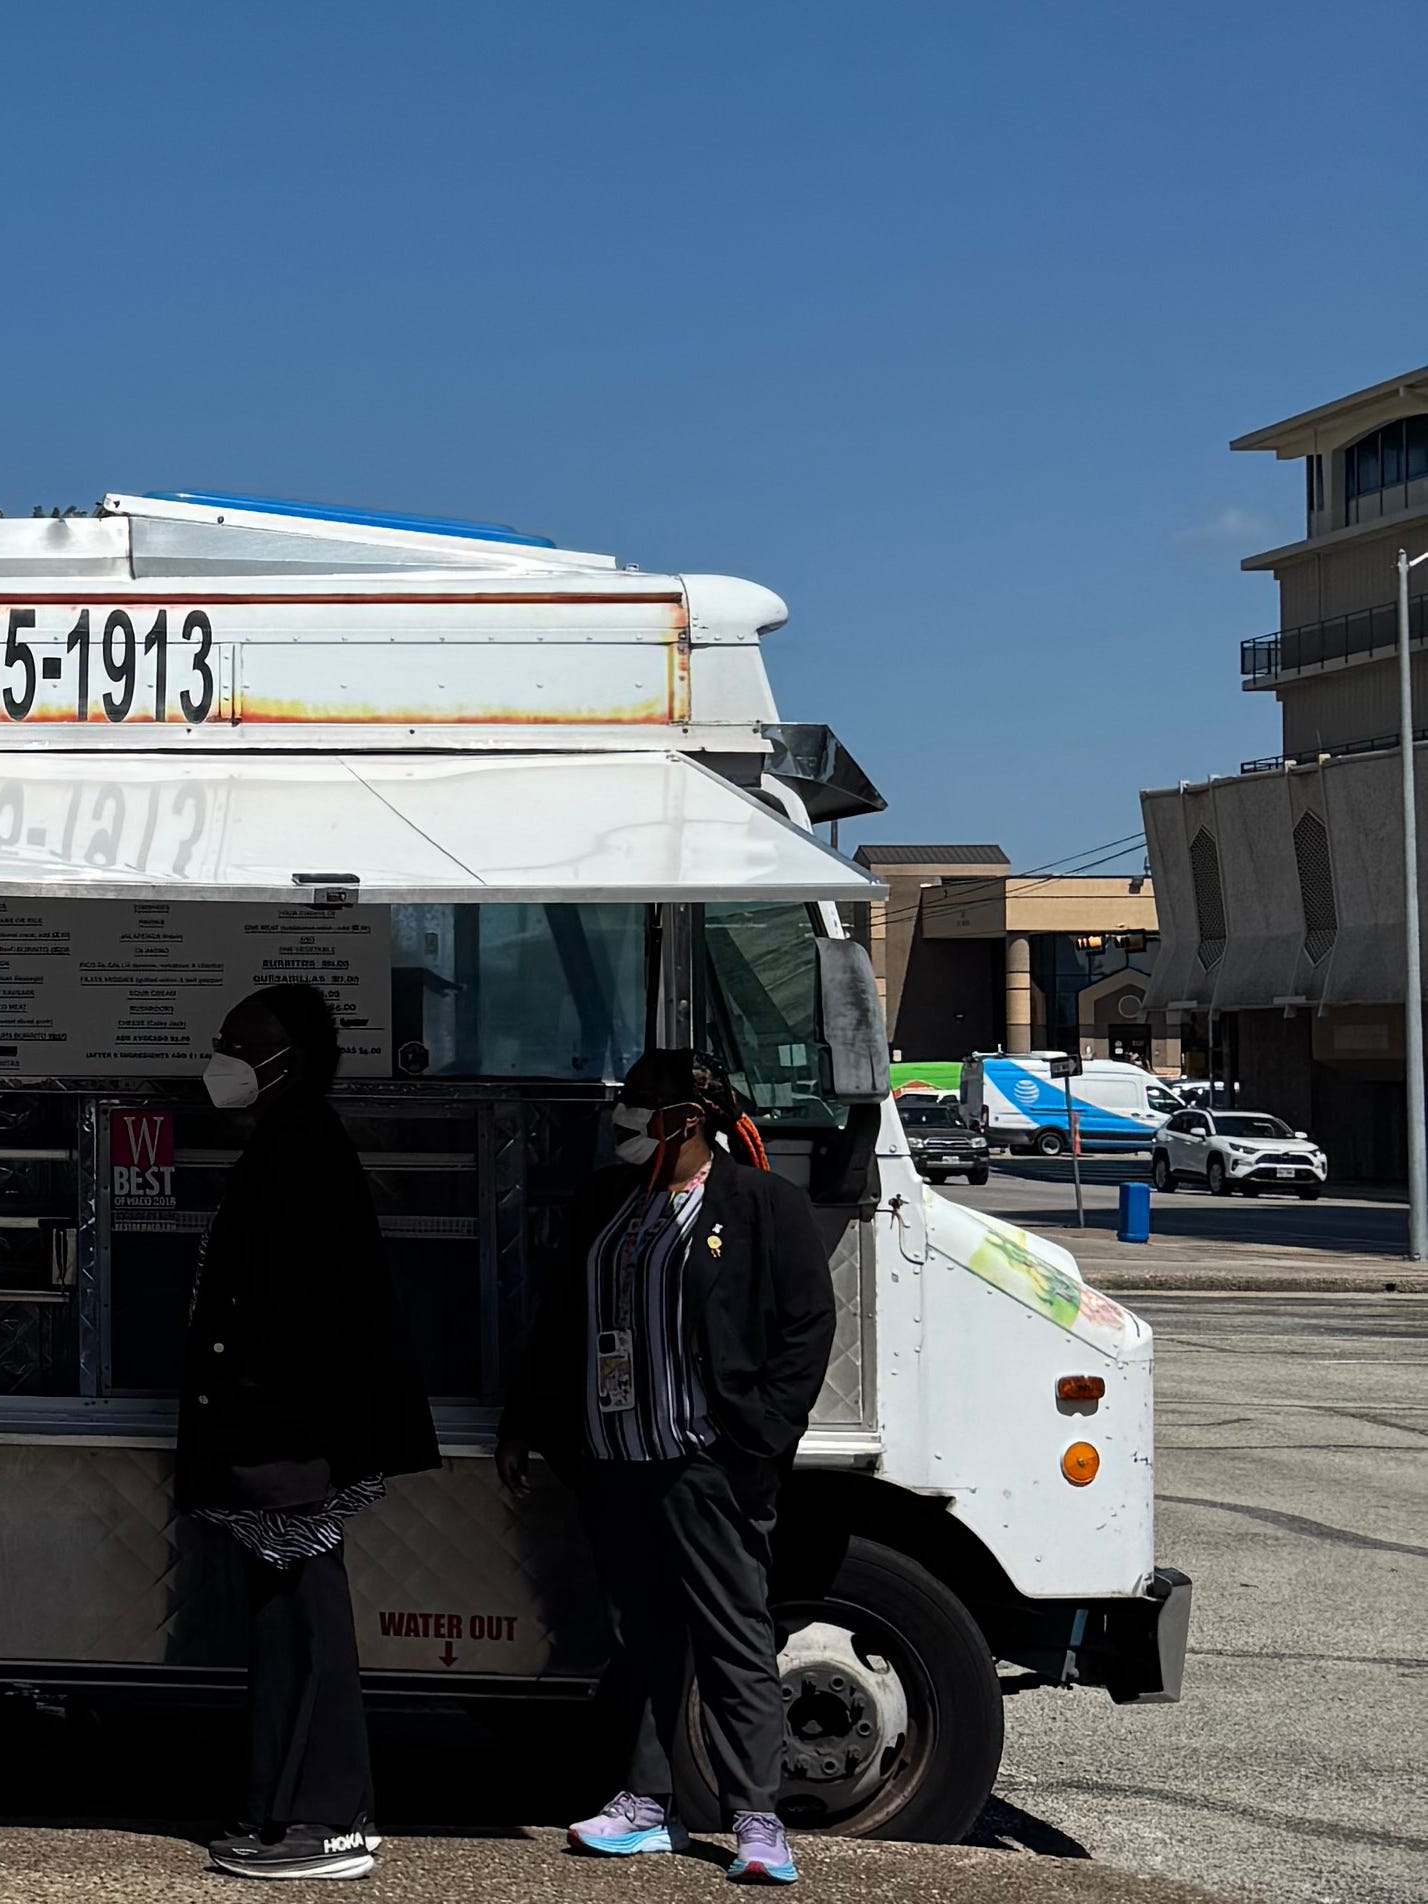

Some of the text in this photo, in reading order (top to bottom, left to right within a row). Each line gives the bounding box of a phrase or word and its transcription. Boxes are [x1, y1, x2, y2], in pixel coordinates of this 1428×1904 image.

[123, 1116, 165, 1166] W
[113, 1165, 176, 1196] BEST
[379, 1611, 518, 1642] WATER OUT
[323, 1831, 364, 1854] HOKA
